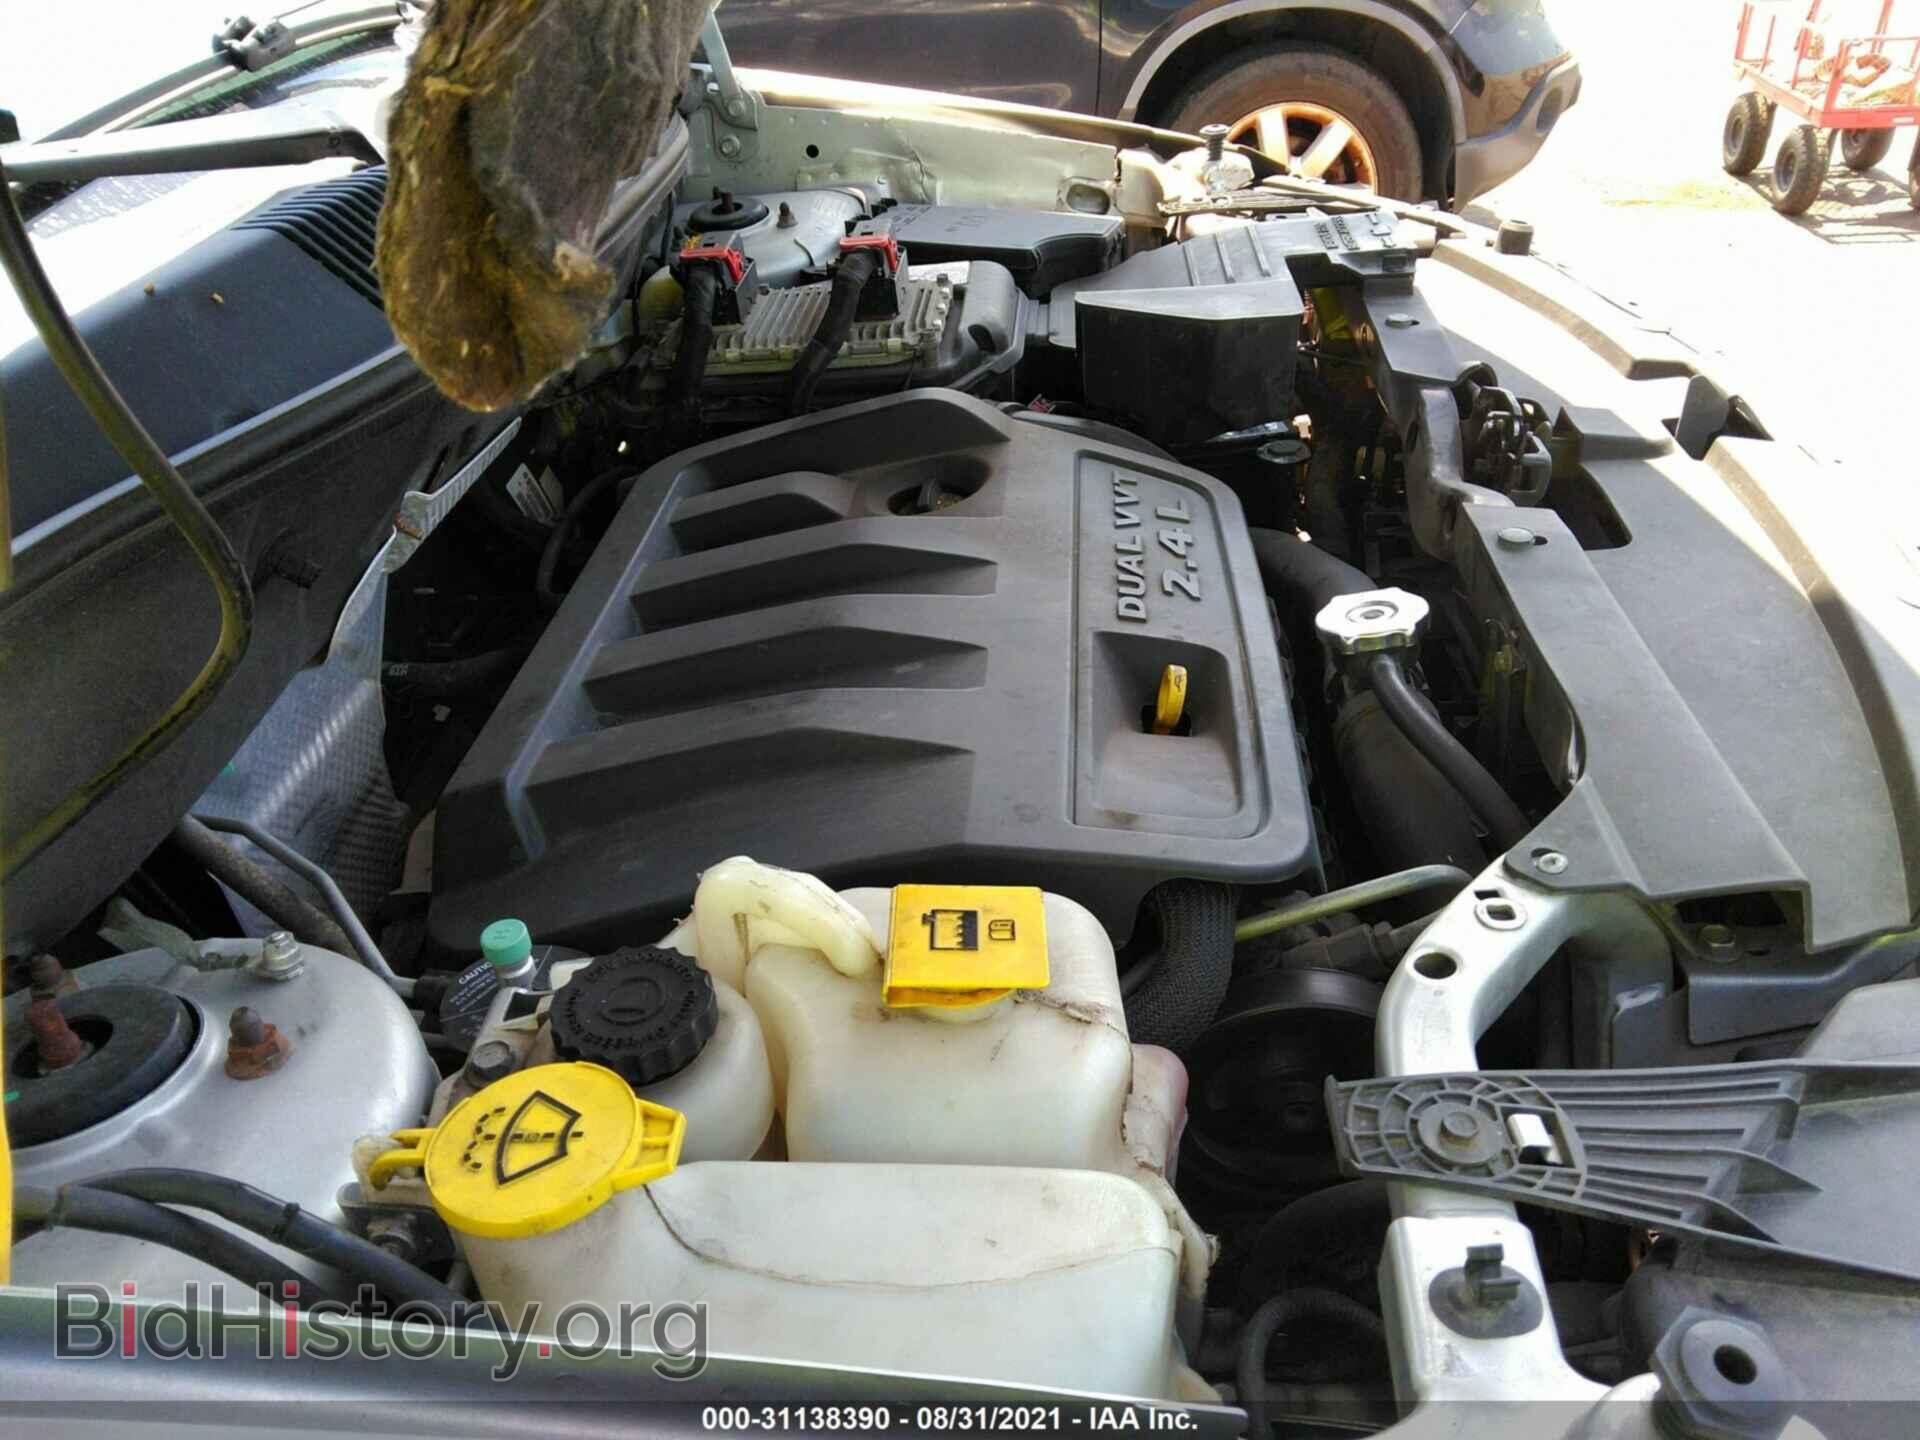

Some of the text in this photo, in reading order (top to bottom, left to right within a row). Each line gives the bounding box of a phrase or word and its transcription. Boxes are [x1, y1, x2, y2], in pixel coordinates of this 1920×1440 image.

[1112, 470, 1148, 624] DUAL VVT
[458, 960, 493, 985] CAUTIO
